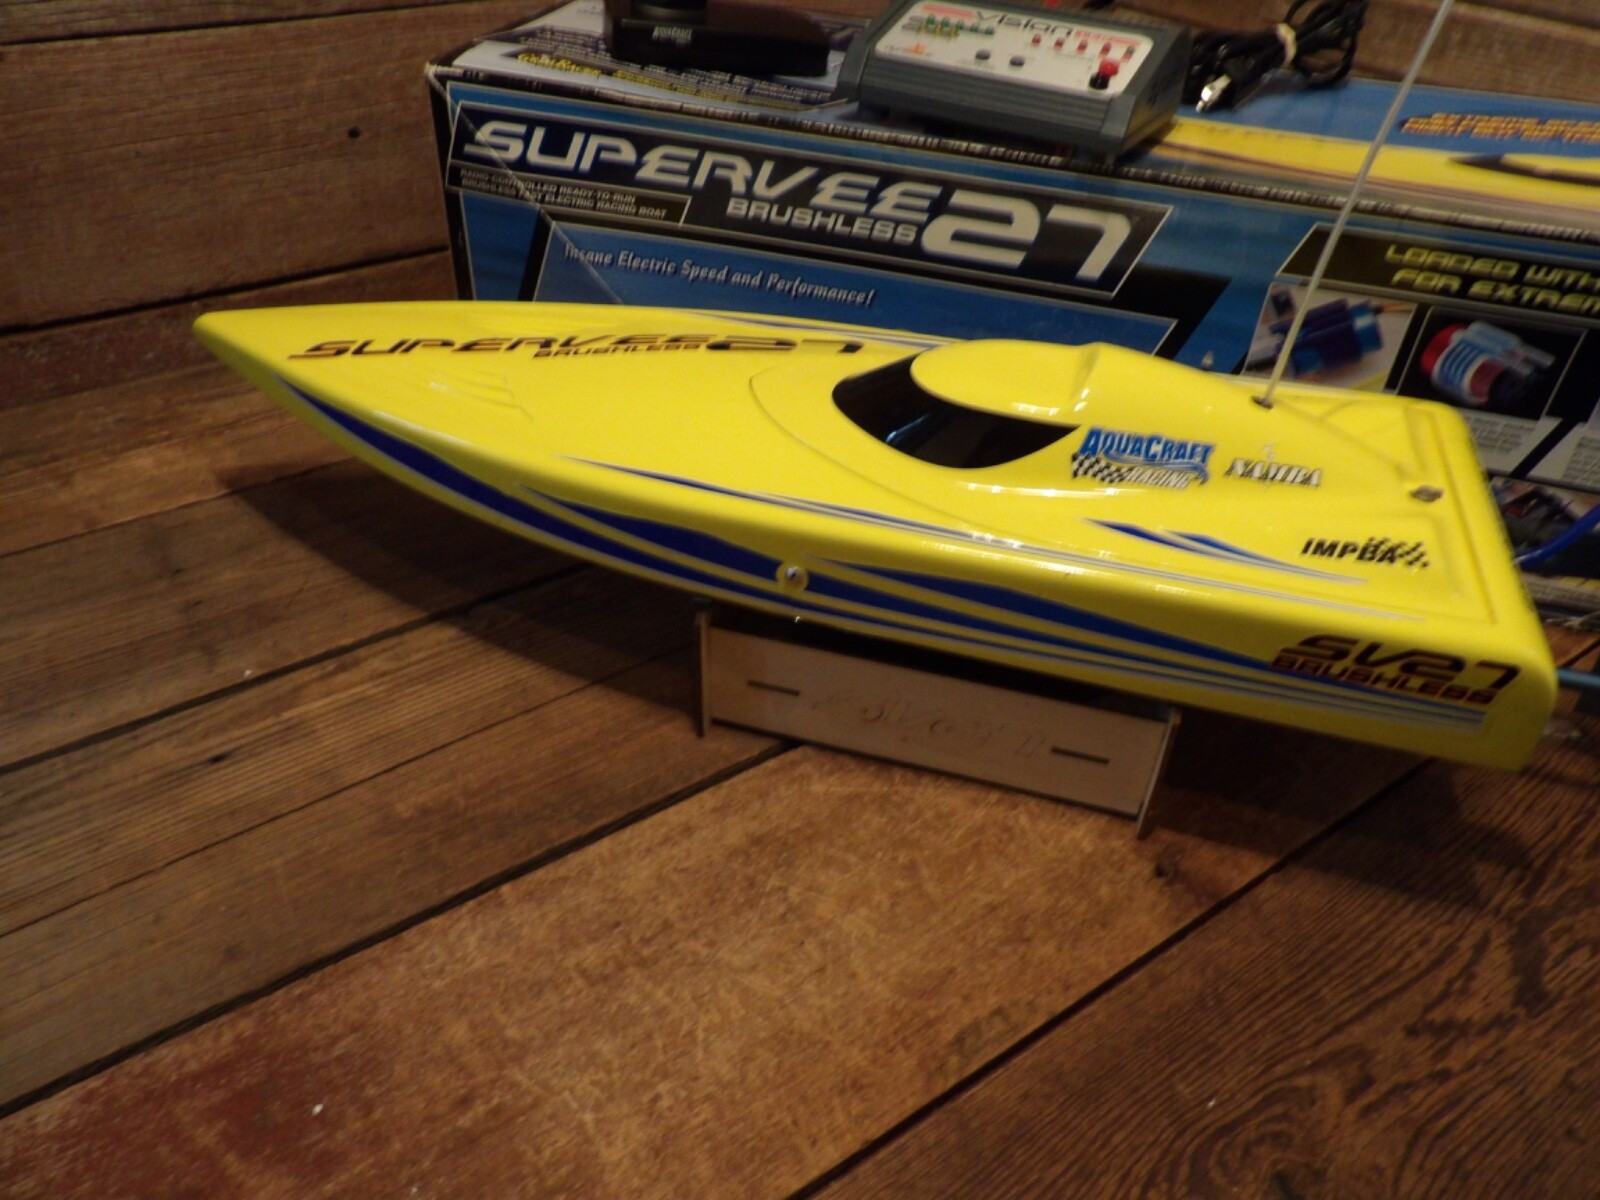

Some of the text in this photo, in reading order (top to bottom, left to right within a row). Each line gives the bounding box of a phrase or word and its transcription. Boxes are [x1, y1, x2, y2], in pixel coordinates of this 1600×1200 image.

[463, 120, 1133, 283] SUPERVEE 27
[545, 191, 594, 209] ELECTRIC
[596, 200, 637, 215] RACING
[638, 205, 669, 219] BOAT
[726, 197, 919, 246] BRUSHLESS
[564, 243, 876, 307] Insane Electric Speed and Performance!
[1384, 243, 1600, 292] LOADED WITH
[1390, 267, 1463, 295] FOR
[288, 335, 863, 359] SUPERVEE 27
[533, 342, 701, 358] BRUSHLESS
[1124, 466, 1192, 490] RACING
[1300, 537, 1398, 565] IMPBA
[1270, 653, 1499, 706] BRUSHLESS
